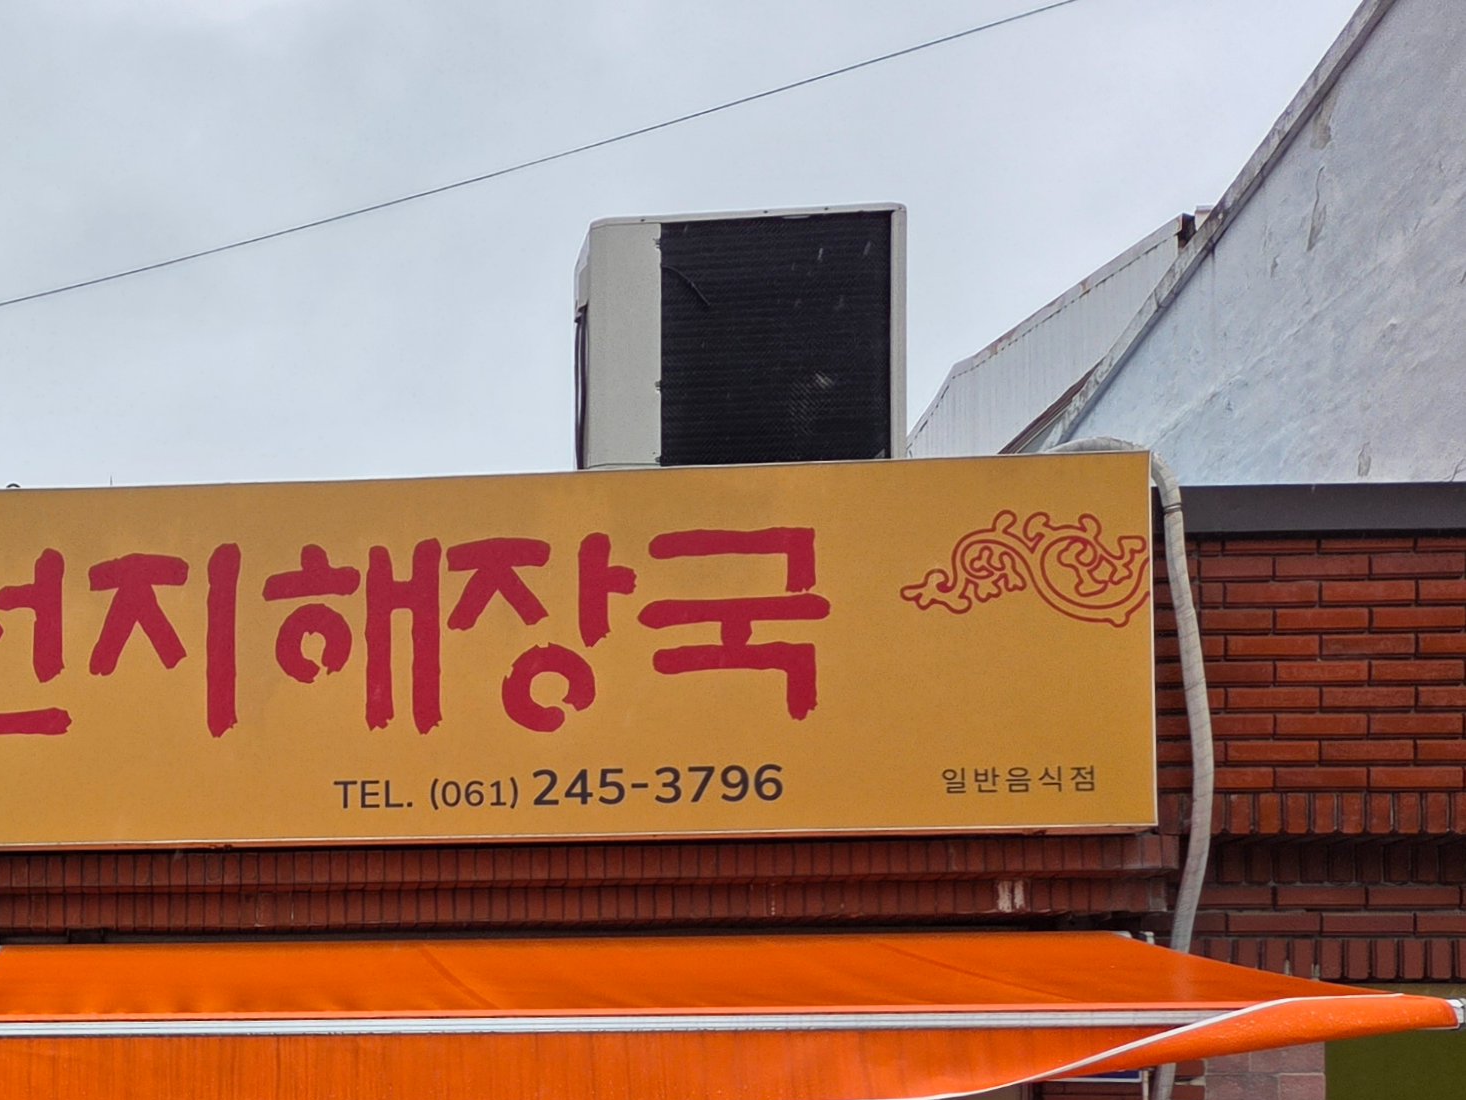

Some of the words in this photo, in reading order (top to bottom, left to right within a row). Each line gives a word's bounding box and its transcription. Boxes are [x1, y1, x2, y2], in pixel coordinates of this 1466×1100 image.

[334, 780, 413, 809] TEL.
[431, 777, 519, 811] (061)
[532, 764, 783, 806] 245-3796
[942, 765, 1095, 794] 일반음식점
